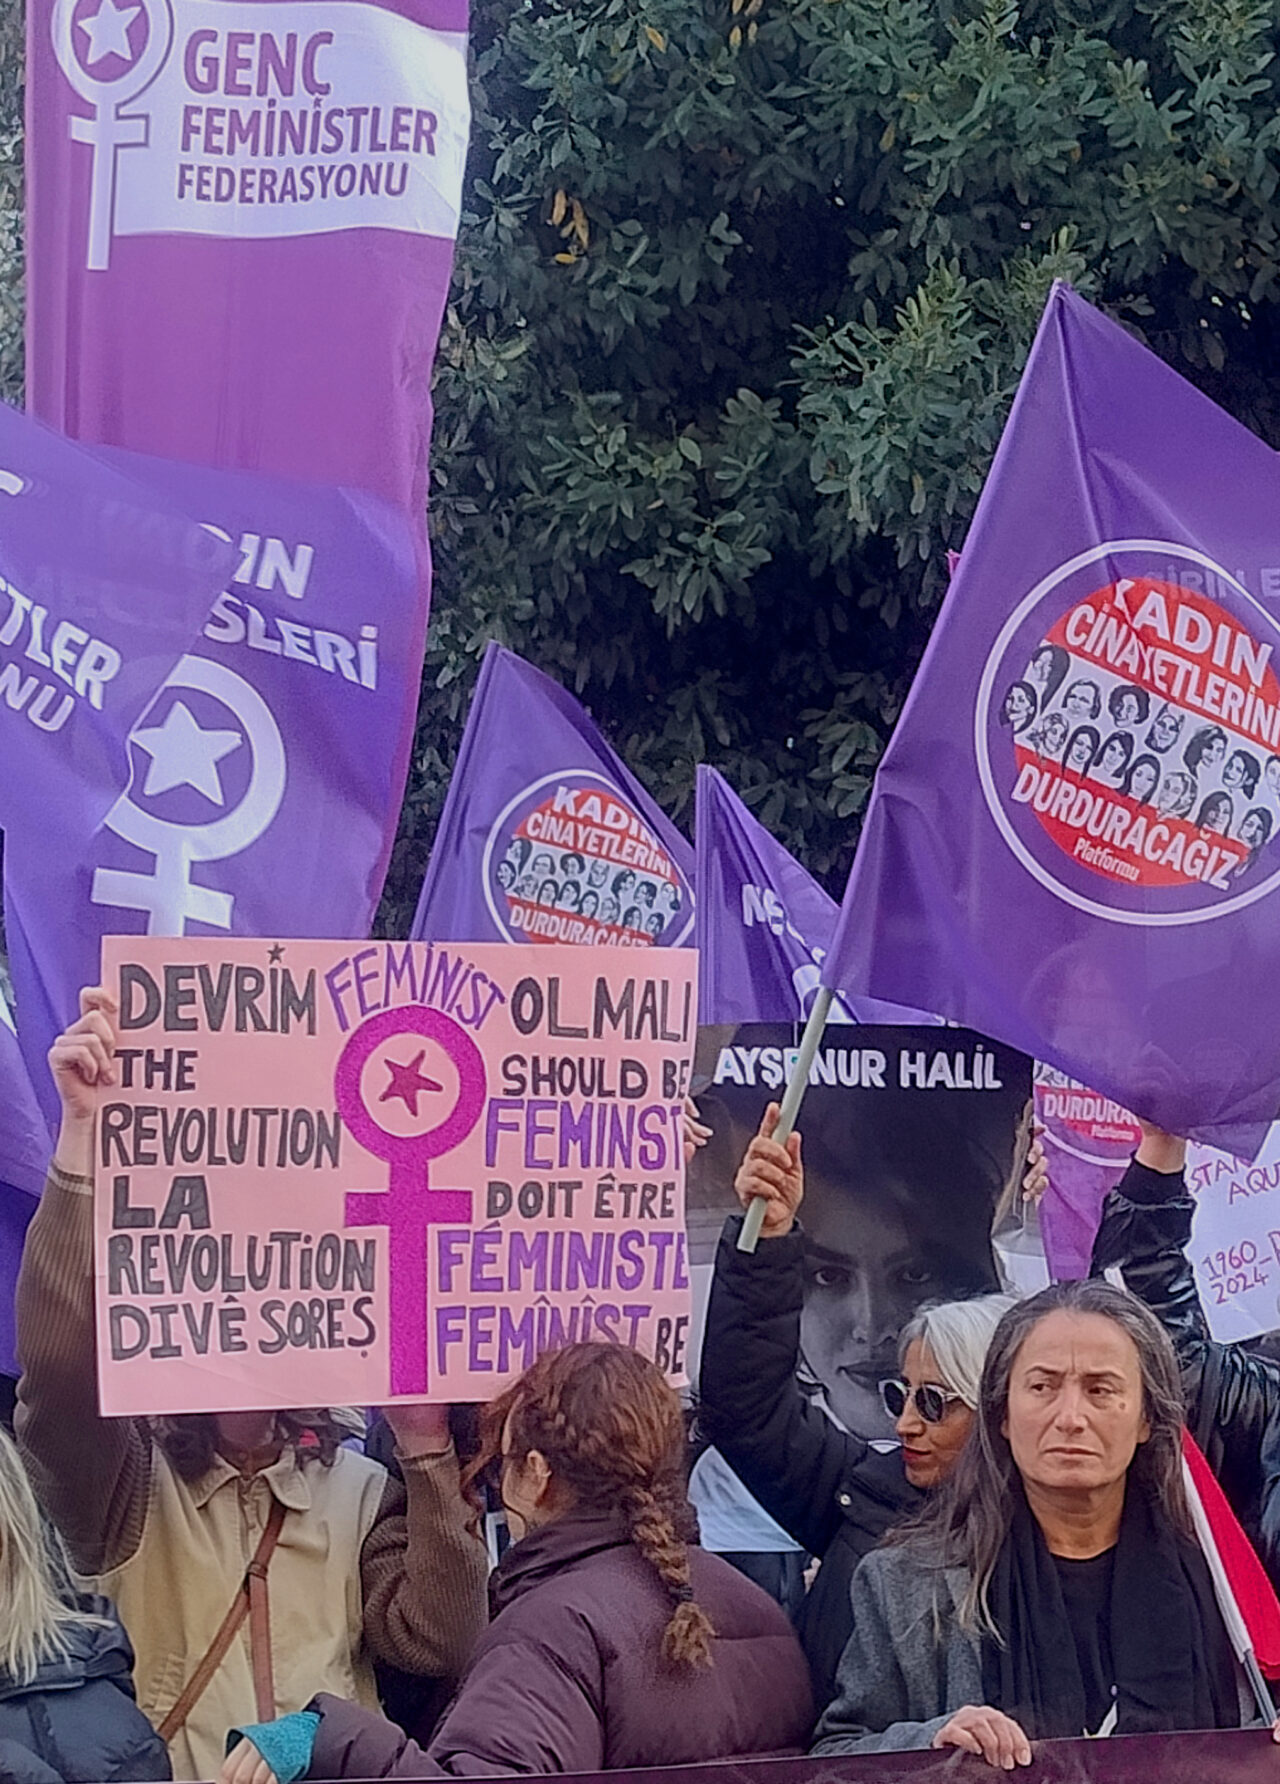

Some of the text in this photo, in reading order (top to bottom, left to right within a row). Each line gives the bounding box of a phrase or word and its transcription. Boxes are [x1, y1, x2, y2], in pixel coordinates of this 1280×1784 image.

[183, 29, 334, 97] GENÇ
[180, 98, 438, 156] FEMİNİSTLER
[177, 161, 408, 203] FEDERASYONU
[1113, 577, 1274, 688] KADIN
[1011, 763, 1240, 892] DURDURACAĞIZ
[113, 1048, 198, 1091] THE
[501, 1055, 691, 1099] SHOULD BE
[900, 1044, 1003, 1090] HALİL
[101, 1102, 341, 1169] REVOLUTION
[485, 1097, 683, 1170] FEMINST
[112, 1175, 211, 1230] LA
[486, 1173, 676, 1219] DOIT ÊTRE
[437, 1220, 689, 1293] FÉMINISTE
[1211, 1266, 1270, 1305] 2024
